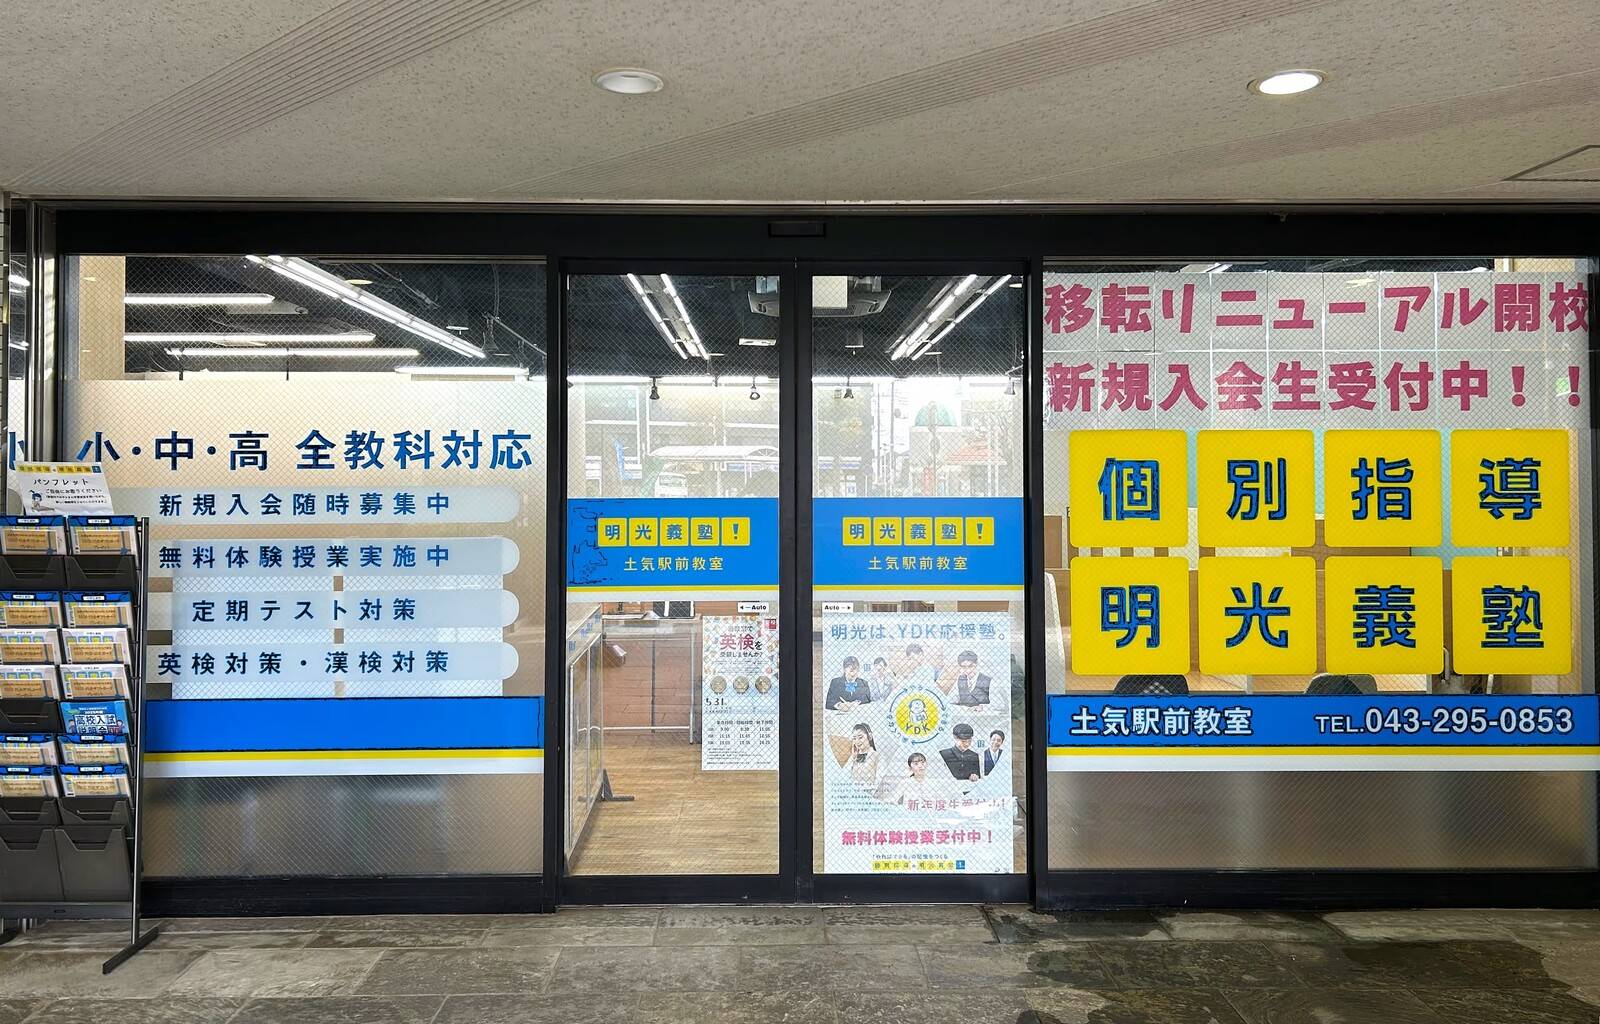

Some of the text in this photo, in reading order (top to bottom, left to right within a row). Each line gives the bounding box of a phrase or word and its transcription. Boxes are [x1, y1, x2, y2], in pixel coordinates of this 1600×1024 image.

[1044, 282, 1589, 334] 移転リニューアル開校
[76, 429, 533, 471] 小・中・高 全教科対応
[33, 478, 89, 486] パンフレット
[1097, 456, 1542, 521] 個別指導
[158, 493, 451, 517] 新規入会随時募集中
[158, 545, 451, 569] 無料体験授業実施中
[623, 556, 725, 572] 土気駅前教室
[867, 556, 968, 571] 土気駅前教室
[191, 598, 417, 623] 定期テスト対策
[1100, 581, 1545, 649] 明光義塾
[830, 623, 1005, 641] 明光は、YDK応援塾。
[157, 649, 449, 675] 英検対策・漢検対策
[76, 715, 116, 725] 高校入試
[905, 723, 931, 735] YDK
[1070, 706, 1253, 737] 土気駅前教室
[1315, 707, 1574, 736] TEL.043-295-0853
